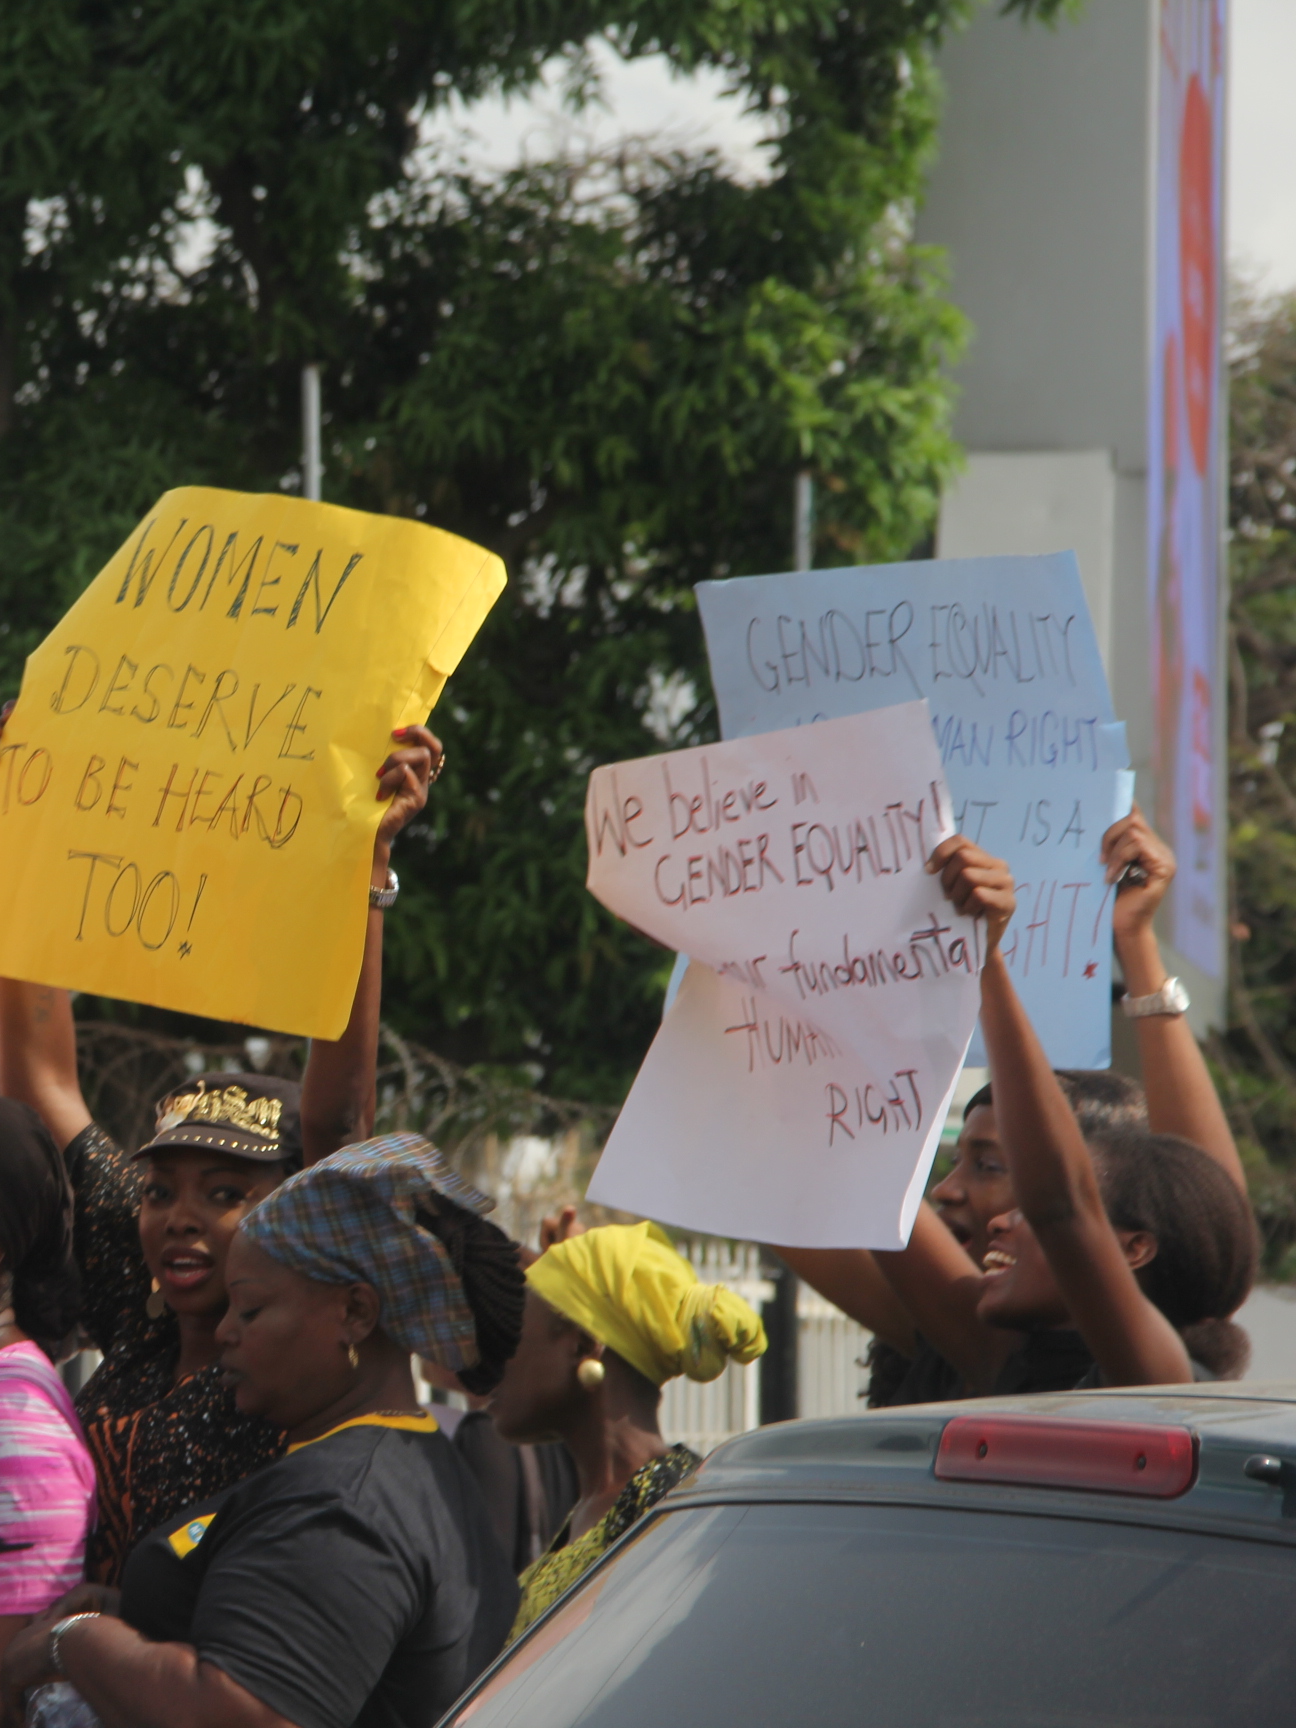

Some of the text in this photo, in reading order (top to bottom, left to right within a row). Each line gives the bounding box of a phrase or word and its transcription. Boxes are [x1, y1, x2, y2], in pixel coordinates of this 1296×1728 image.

[115, 516, 364, 635] WOMEN
[746, 600, 1076, 698] GENDER EQUALITY
[50, 644, 322, 762] DESERVE
[1005, 709, 1098, 772] RIGHT
[74, 754, 140, 820] BE
[151, 763, 304, 849] HEARD
[588, 755, 821, 859] We believe in
[653, 779, 947, 912] GENDER EQUALITY!
[1018, 799, 1052, 847] IS
[1057, 798, 1086, 848] A
[66, 848, 209, 960] TOO!
[777, 912, 981, 1001] fundamental
[824, 1068, 920, 1148] RIGHT
